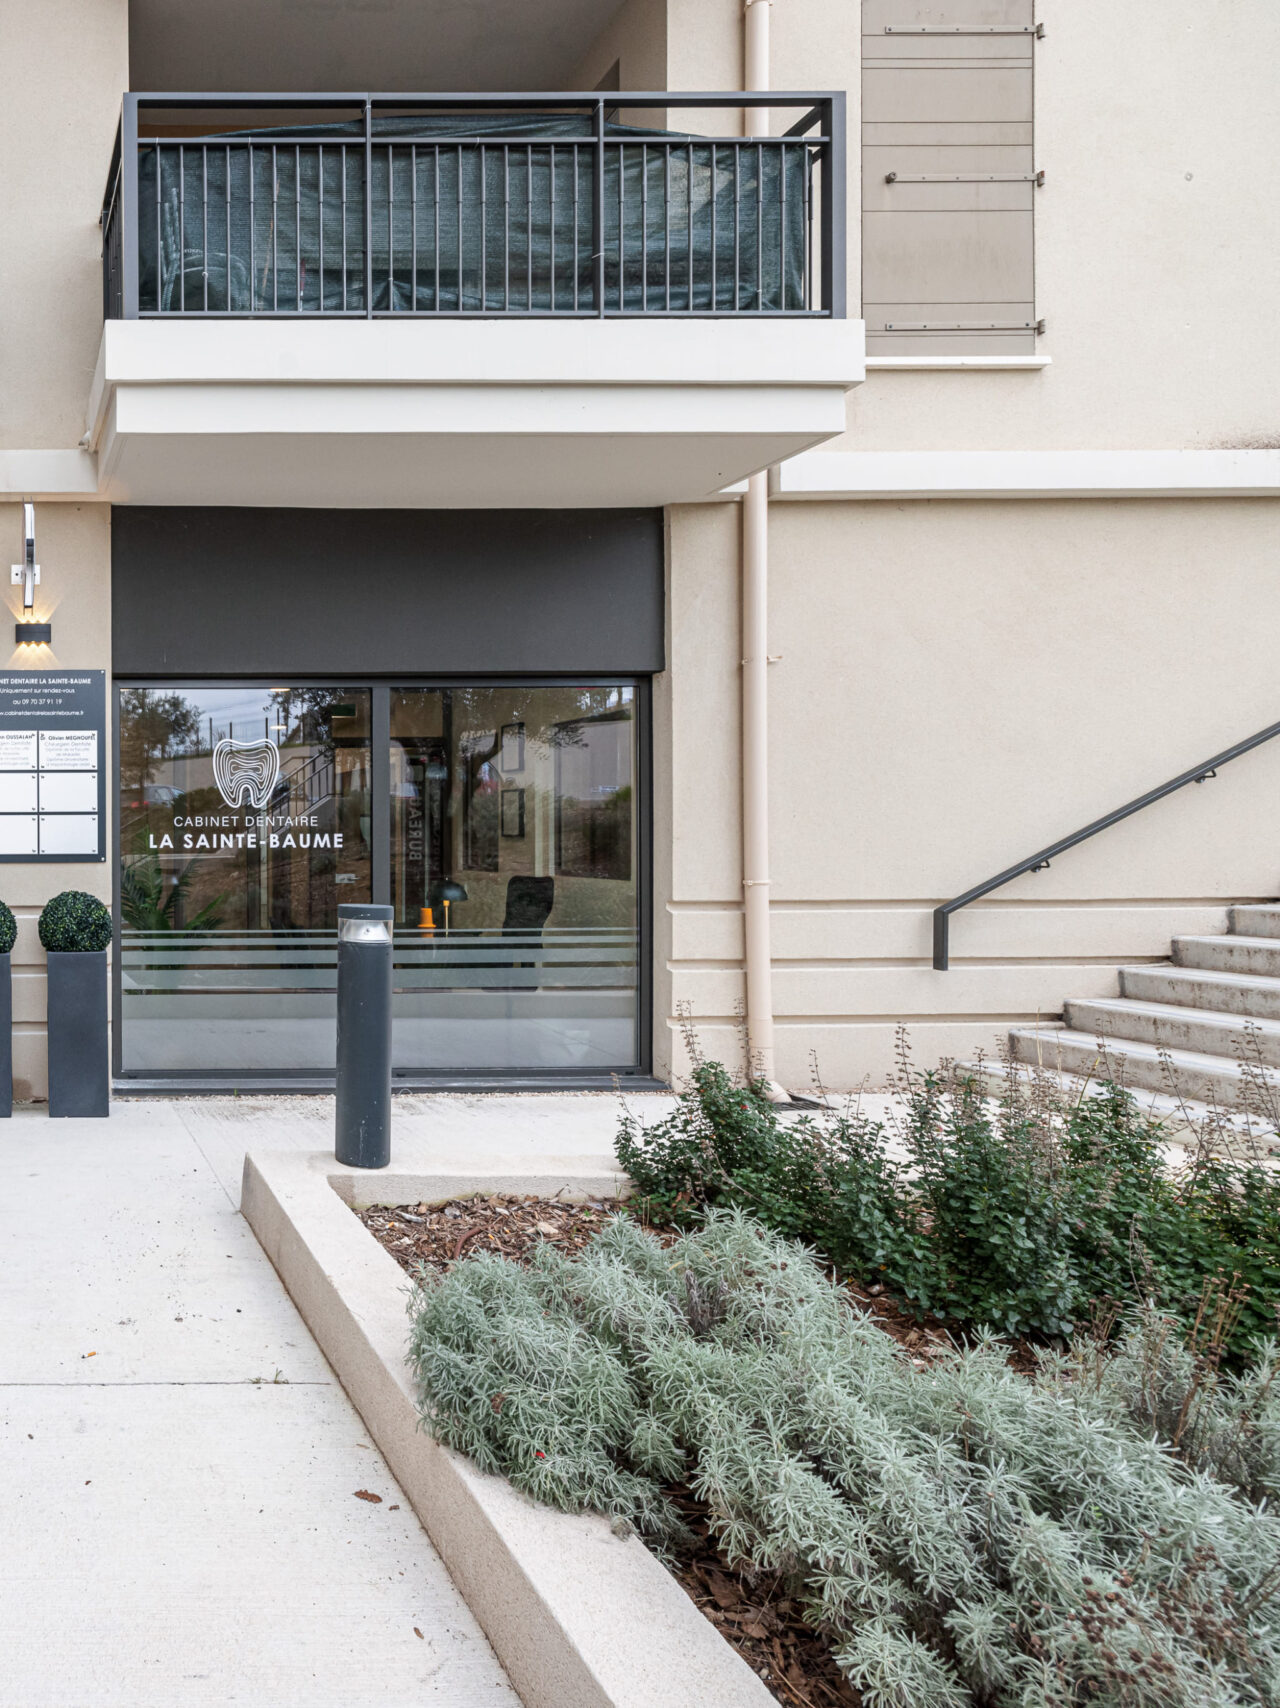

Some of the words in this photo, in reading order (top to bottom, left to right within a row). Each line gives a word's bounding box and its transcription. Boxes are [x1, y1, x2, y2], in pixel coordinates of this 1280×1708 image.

[0, 687, 33, 695] Uniquement
[173, 815, 240, 827] CABINET
[245, 815, 319, 827] DENTAIRE
[149, 833, 174, 849] LA
[183, 833, 344, 849] SAINTE-BAUME
